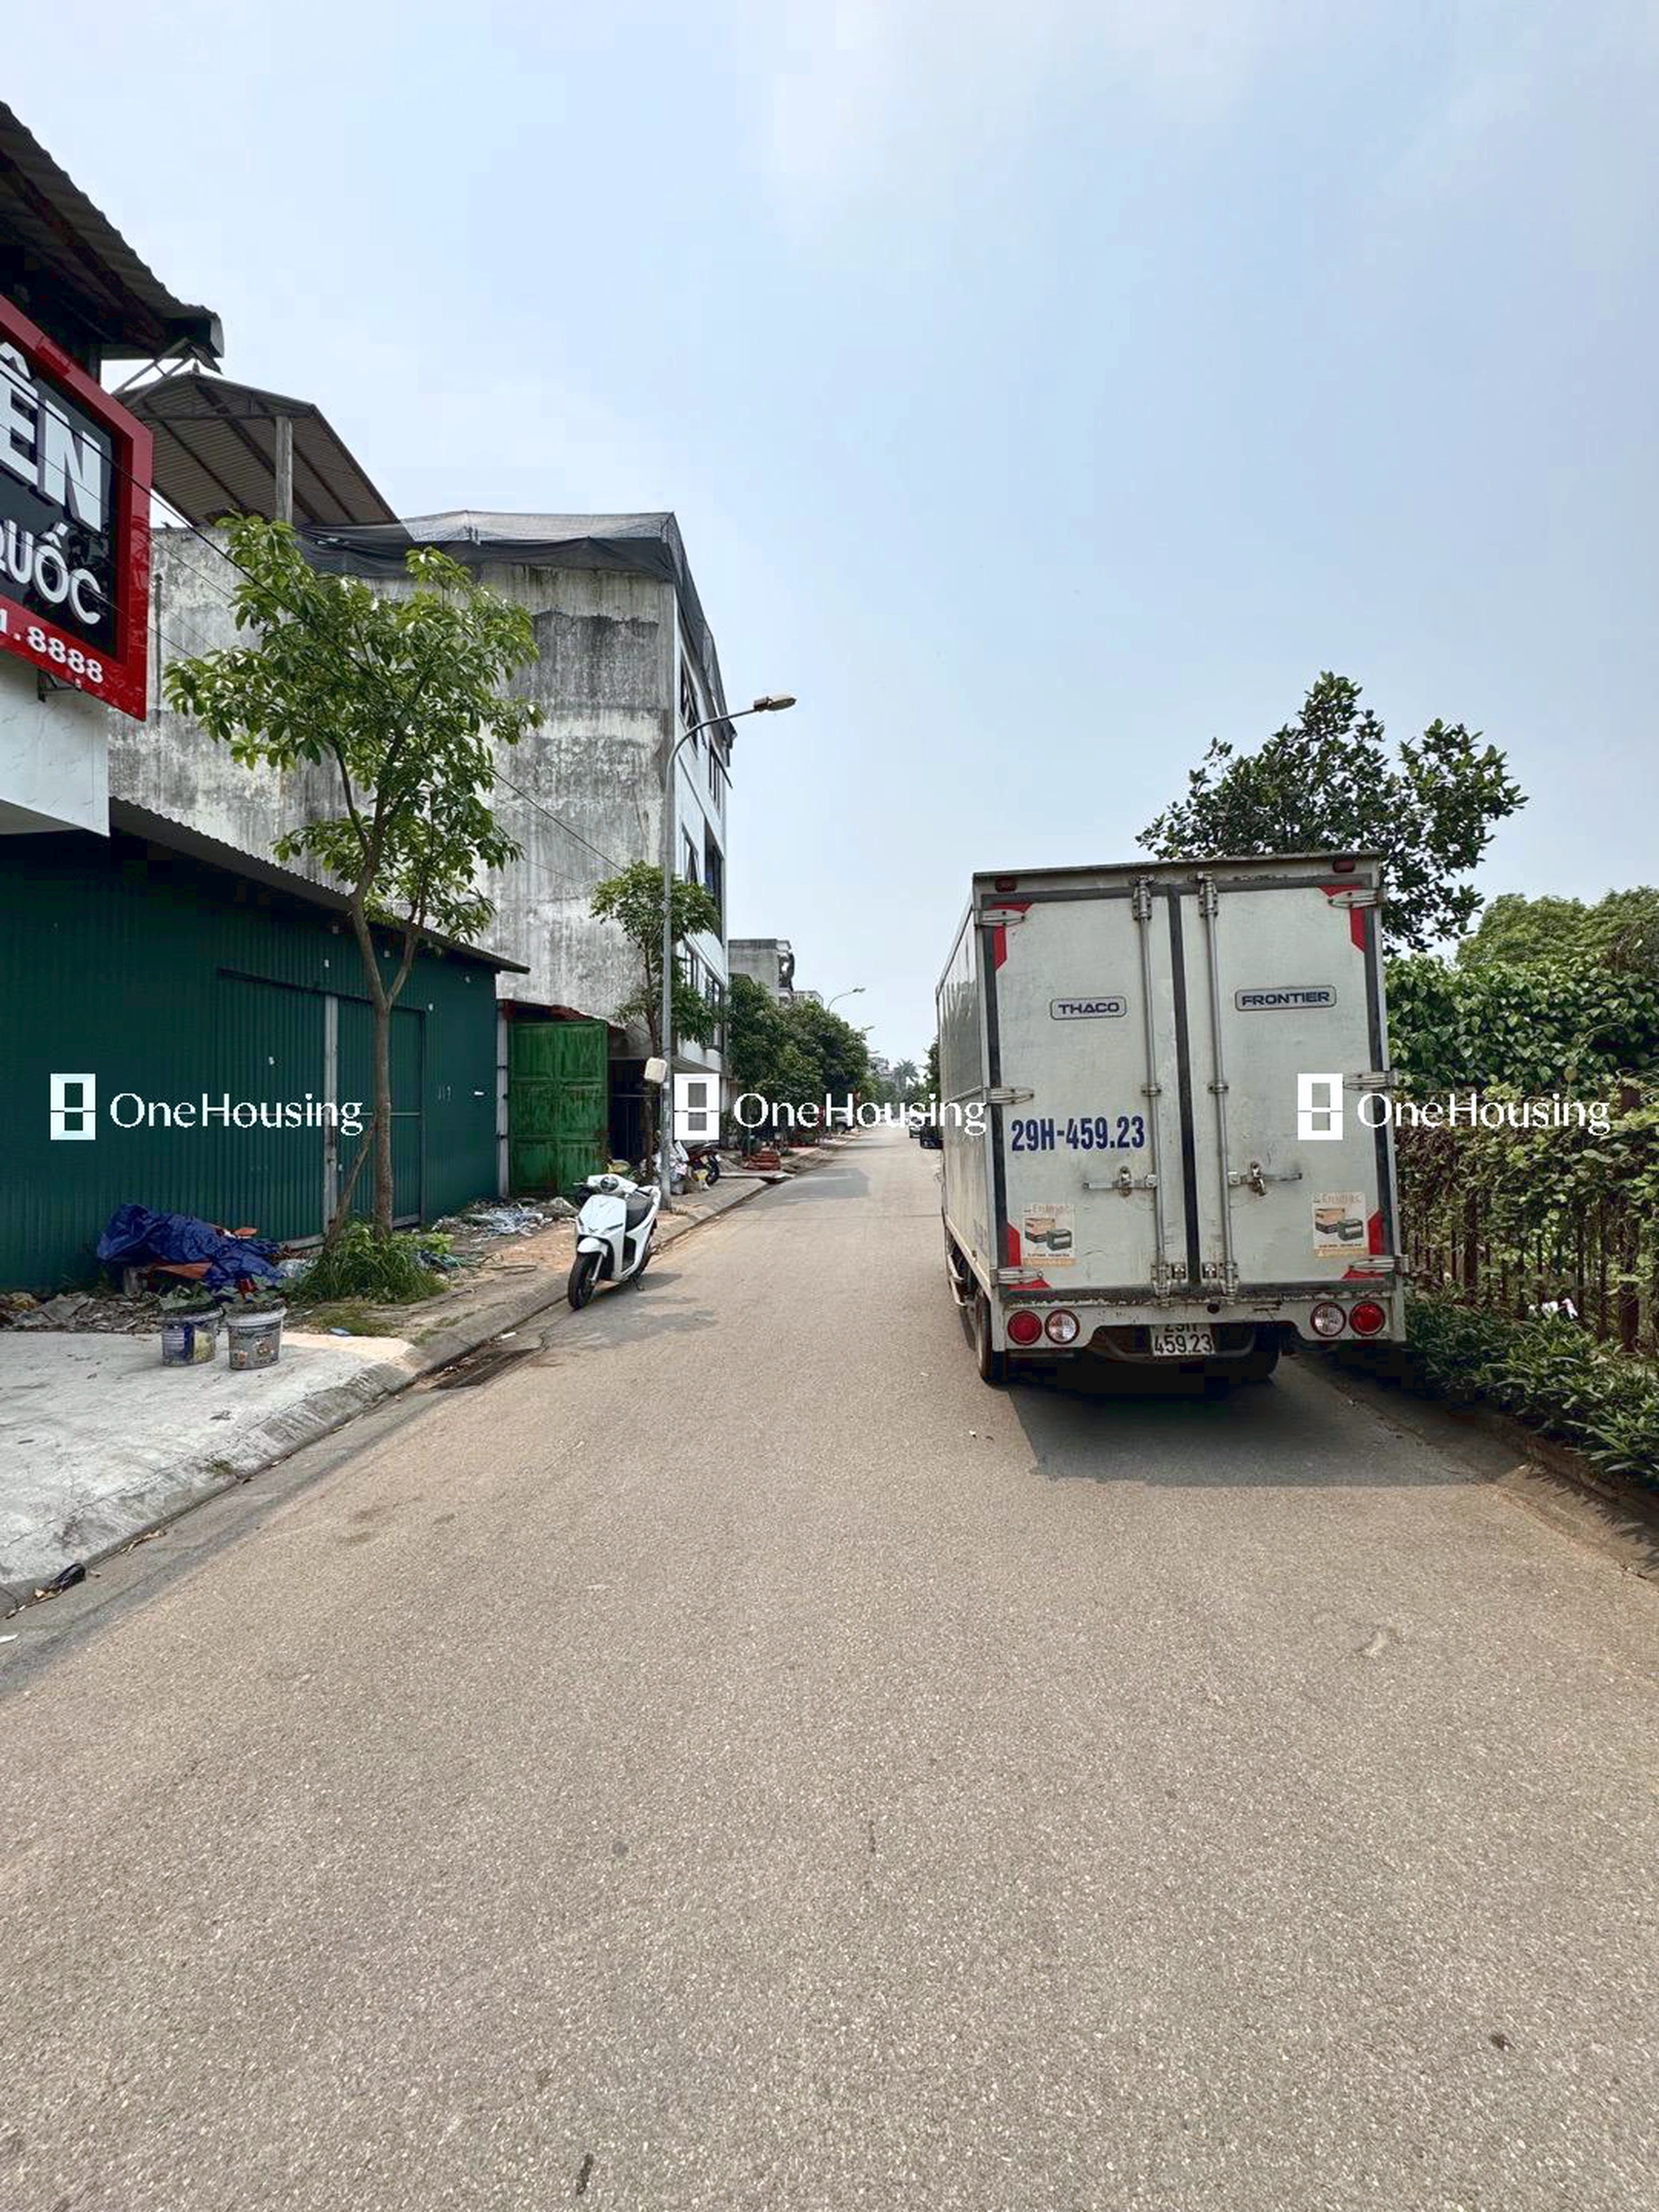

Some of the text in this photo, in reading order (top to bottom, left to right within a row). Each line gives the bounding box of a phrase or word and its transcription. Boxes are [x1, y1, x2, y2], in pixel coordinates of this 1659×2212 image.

[0, 519, 102, 624] UỐC
[1057, 1001, 1121, 1015] THACO
[1240, 991, 1331, 1006] FRONTIER
[1010, 1115, 1145, 1151] 29H-459.23
[1154, 1333, 1213, 1354] 459.23
